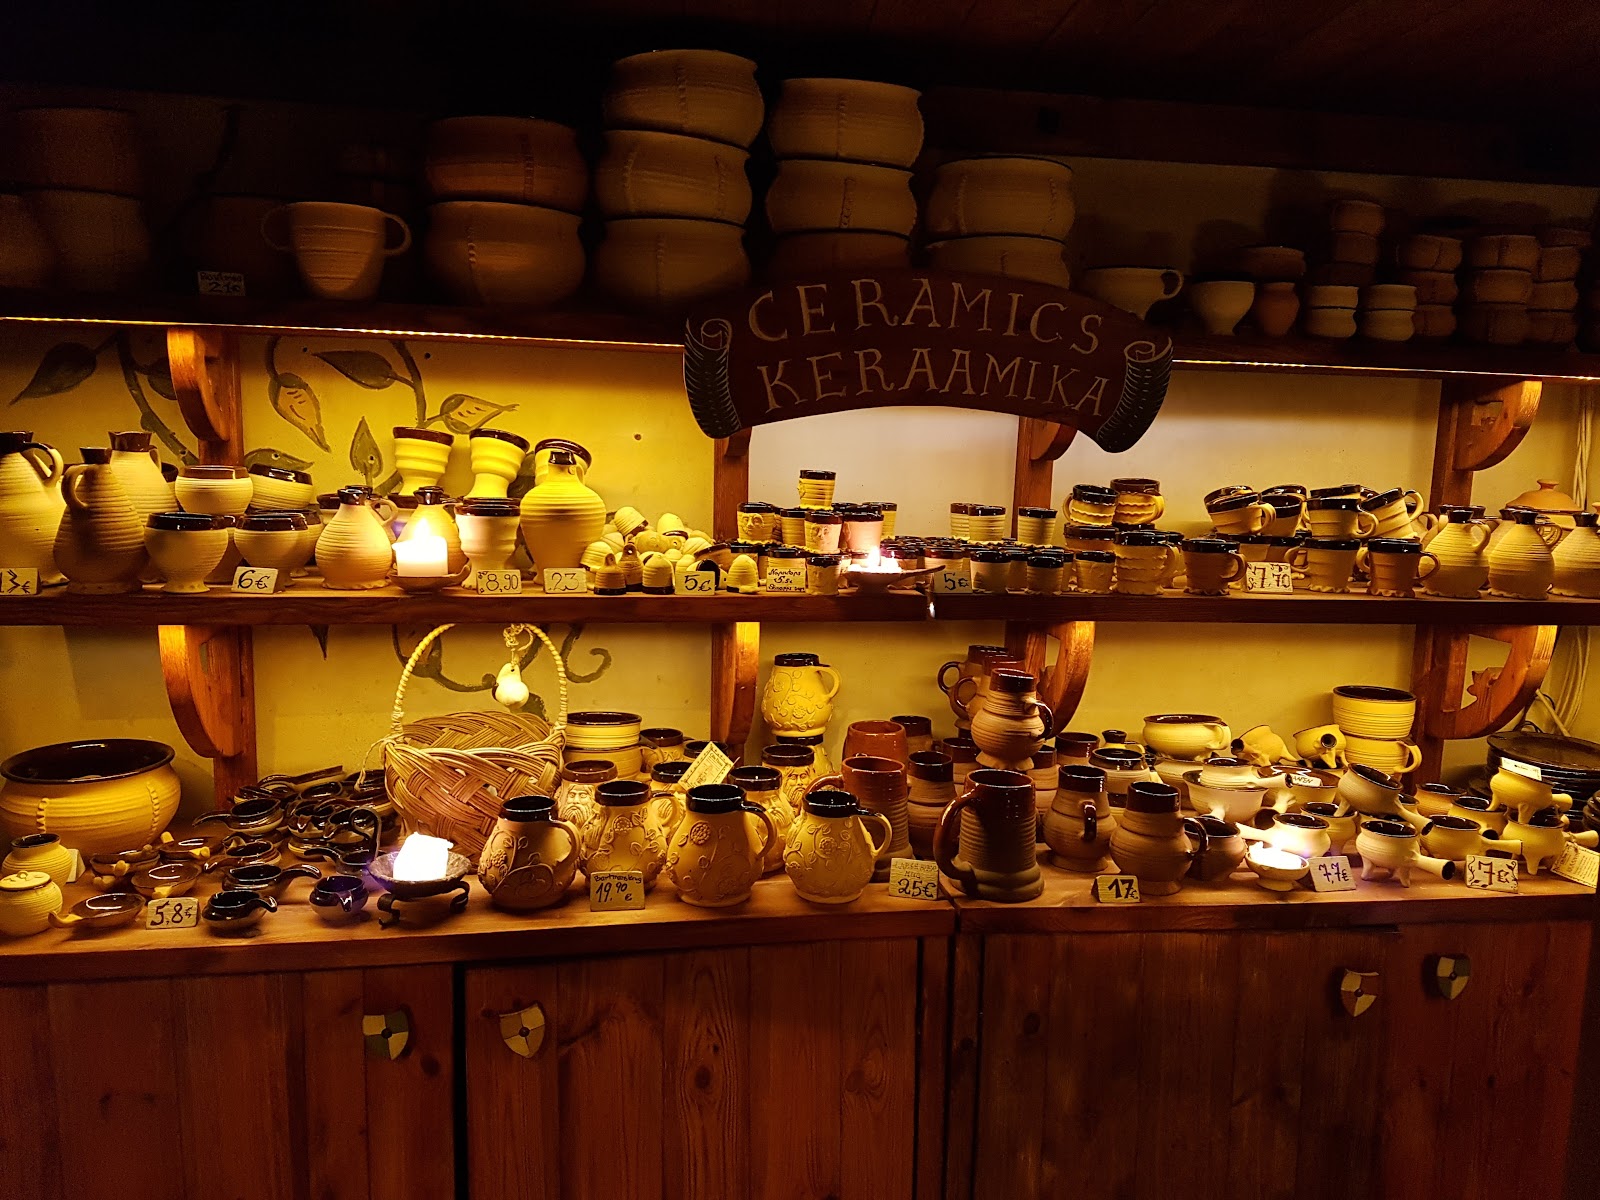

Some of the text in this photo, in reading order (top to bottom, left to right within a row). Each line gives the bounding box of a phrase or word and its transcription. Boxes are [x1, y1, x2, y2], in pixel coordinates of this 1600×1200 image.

[748, 278, 1104, 355] CERAMICS
[757, 347, 1111, 416] KERAAMIKA
[684, 574, 712, 592] 5€
[943, 572, 970, 591] 5€
[898, 878, 937, 898] 25€
